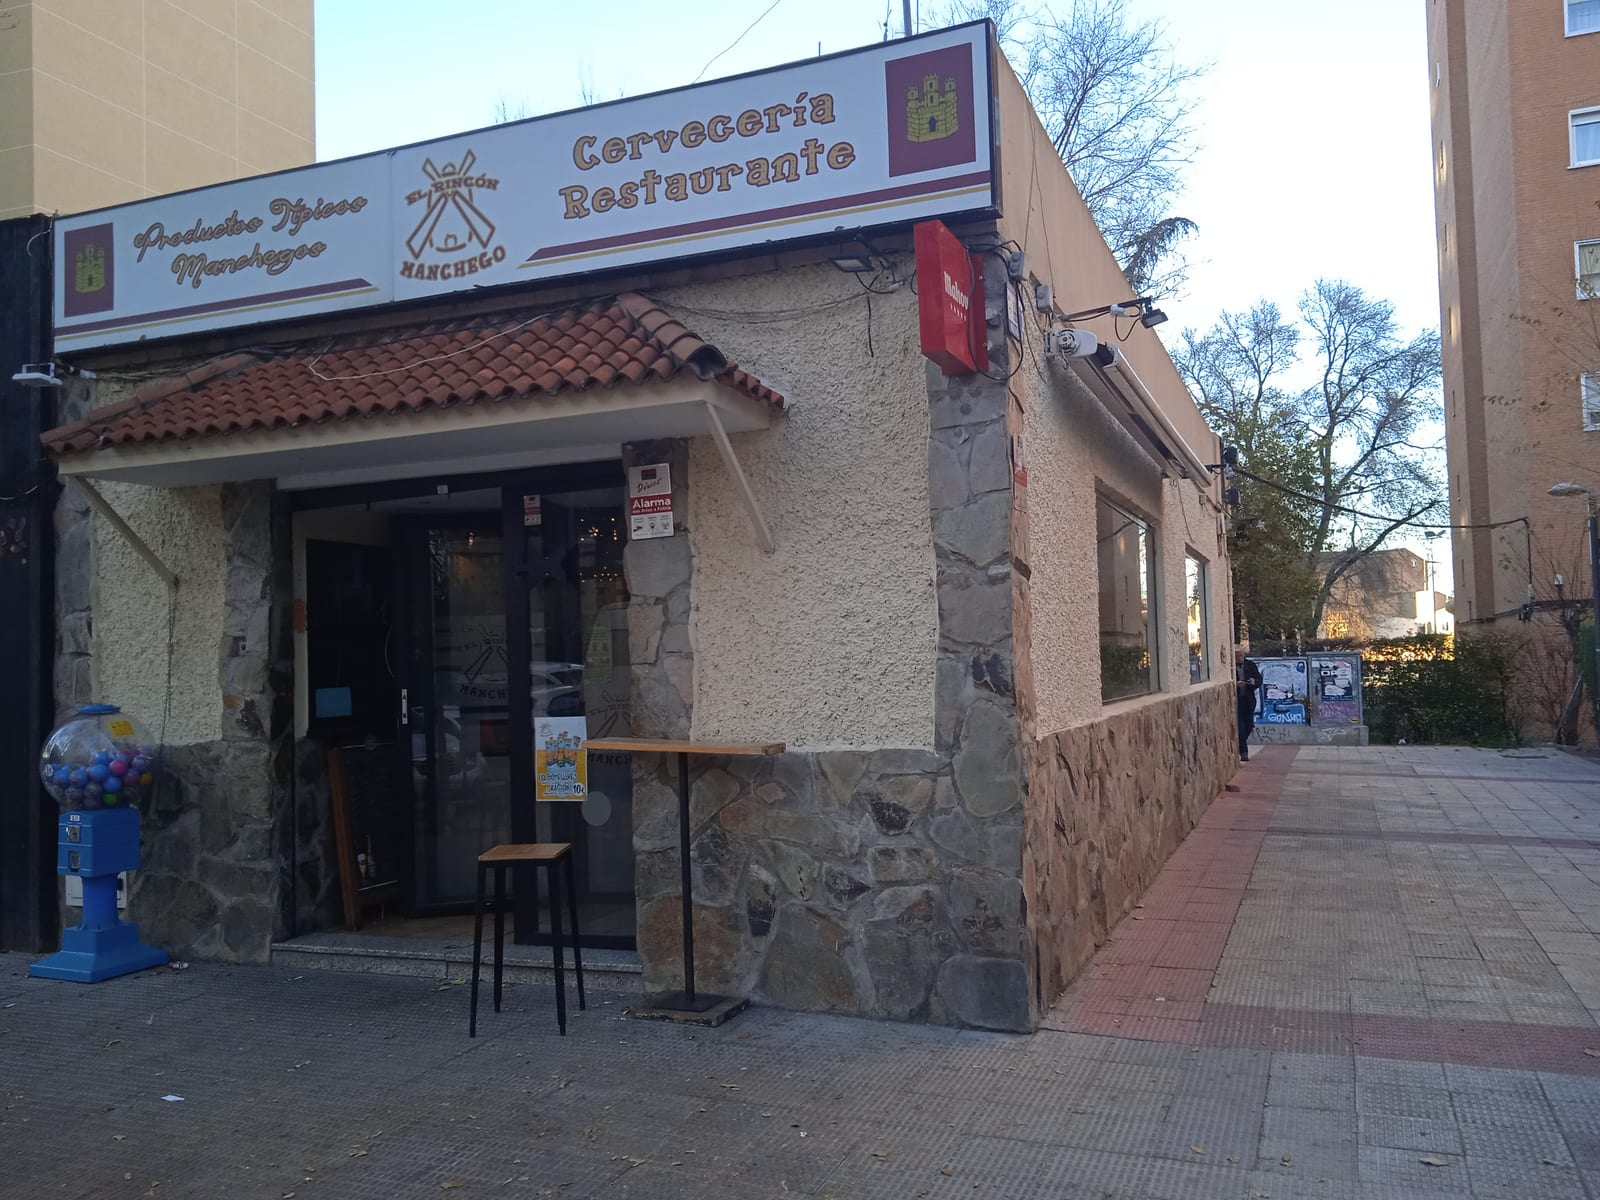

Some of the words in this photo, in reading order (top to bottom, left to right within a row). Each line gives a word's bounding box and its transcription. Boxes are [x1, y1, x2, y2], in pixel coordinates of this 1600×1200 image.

[572, 91, 836, 171] Cervecería
[405, 189, 428, 206] EL
[431, 172, 500, 193] RINCÓN
[559, 138, 856, 220] Restaurante
[134, 210, 264, 263] Productos
[171, 241, 327, 289] Manchegos
[400, 245, 506, 281] MANCHEGO
[943, 270, 969, 311] Mahou
[632, 498, 671, 509] Alarma
[459, 684, 506, 699] MANCH
[588, 752, 632, 766] MANCH
